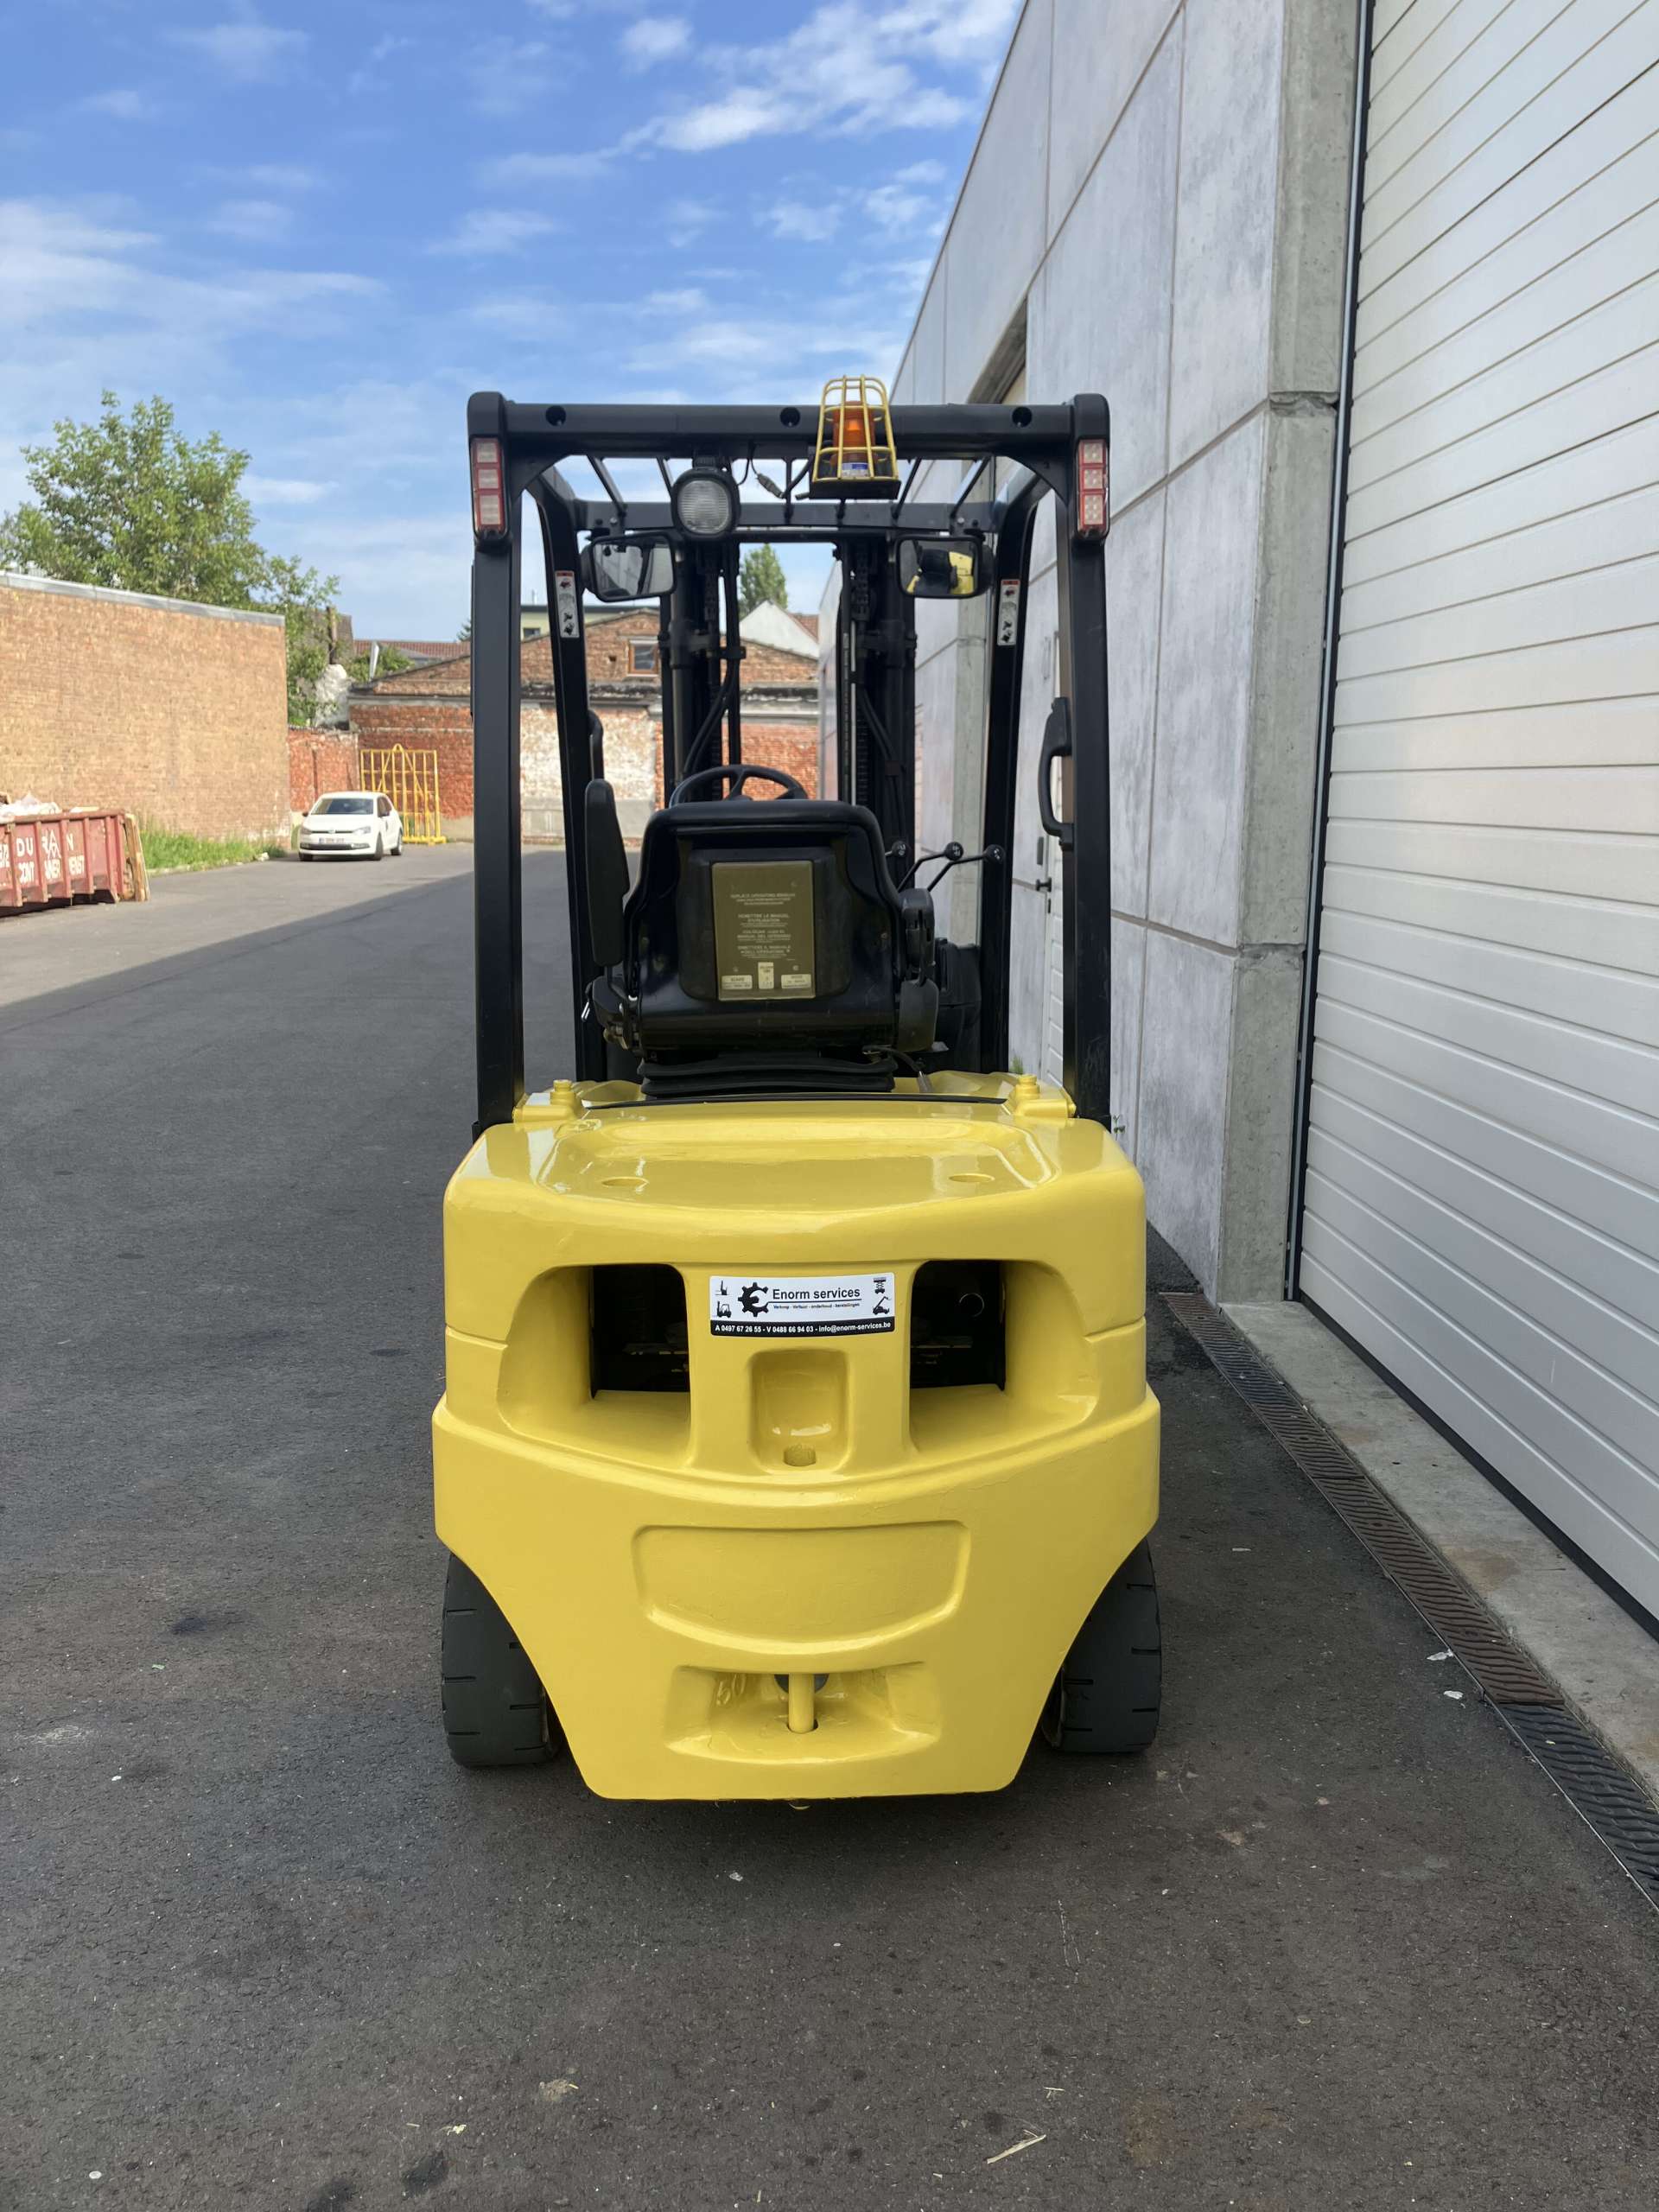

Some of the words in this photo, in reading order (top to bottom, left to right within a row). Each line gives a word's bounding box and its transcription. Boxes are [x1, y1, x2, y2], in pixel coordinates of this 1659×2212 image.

[772, 1288, 810, 1300] Enorm
[813, 1287, 861, 1300] services
[818, 1321, 891, 1332] info@enorm-services.be
